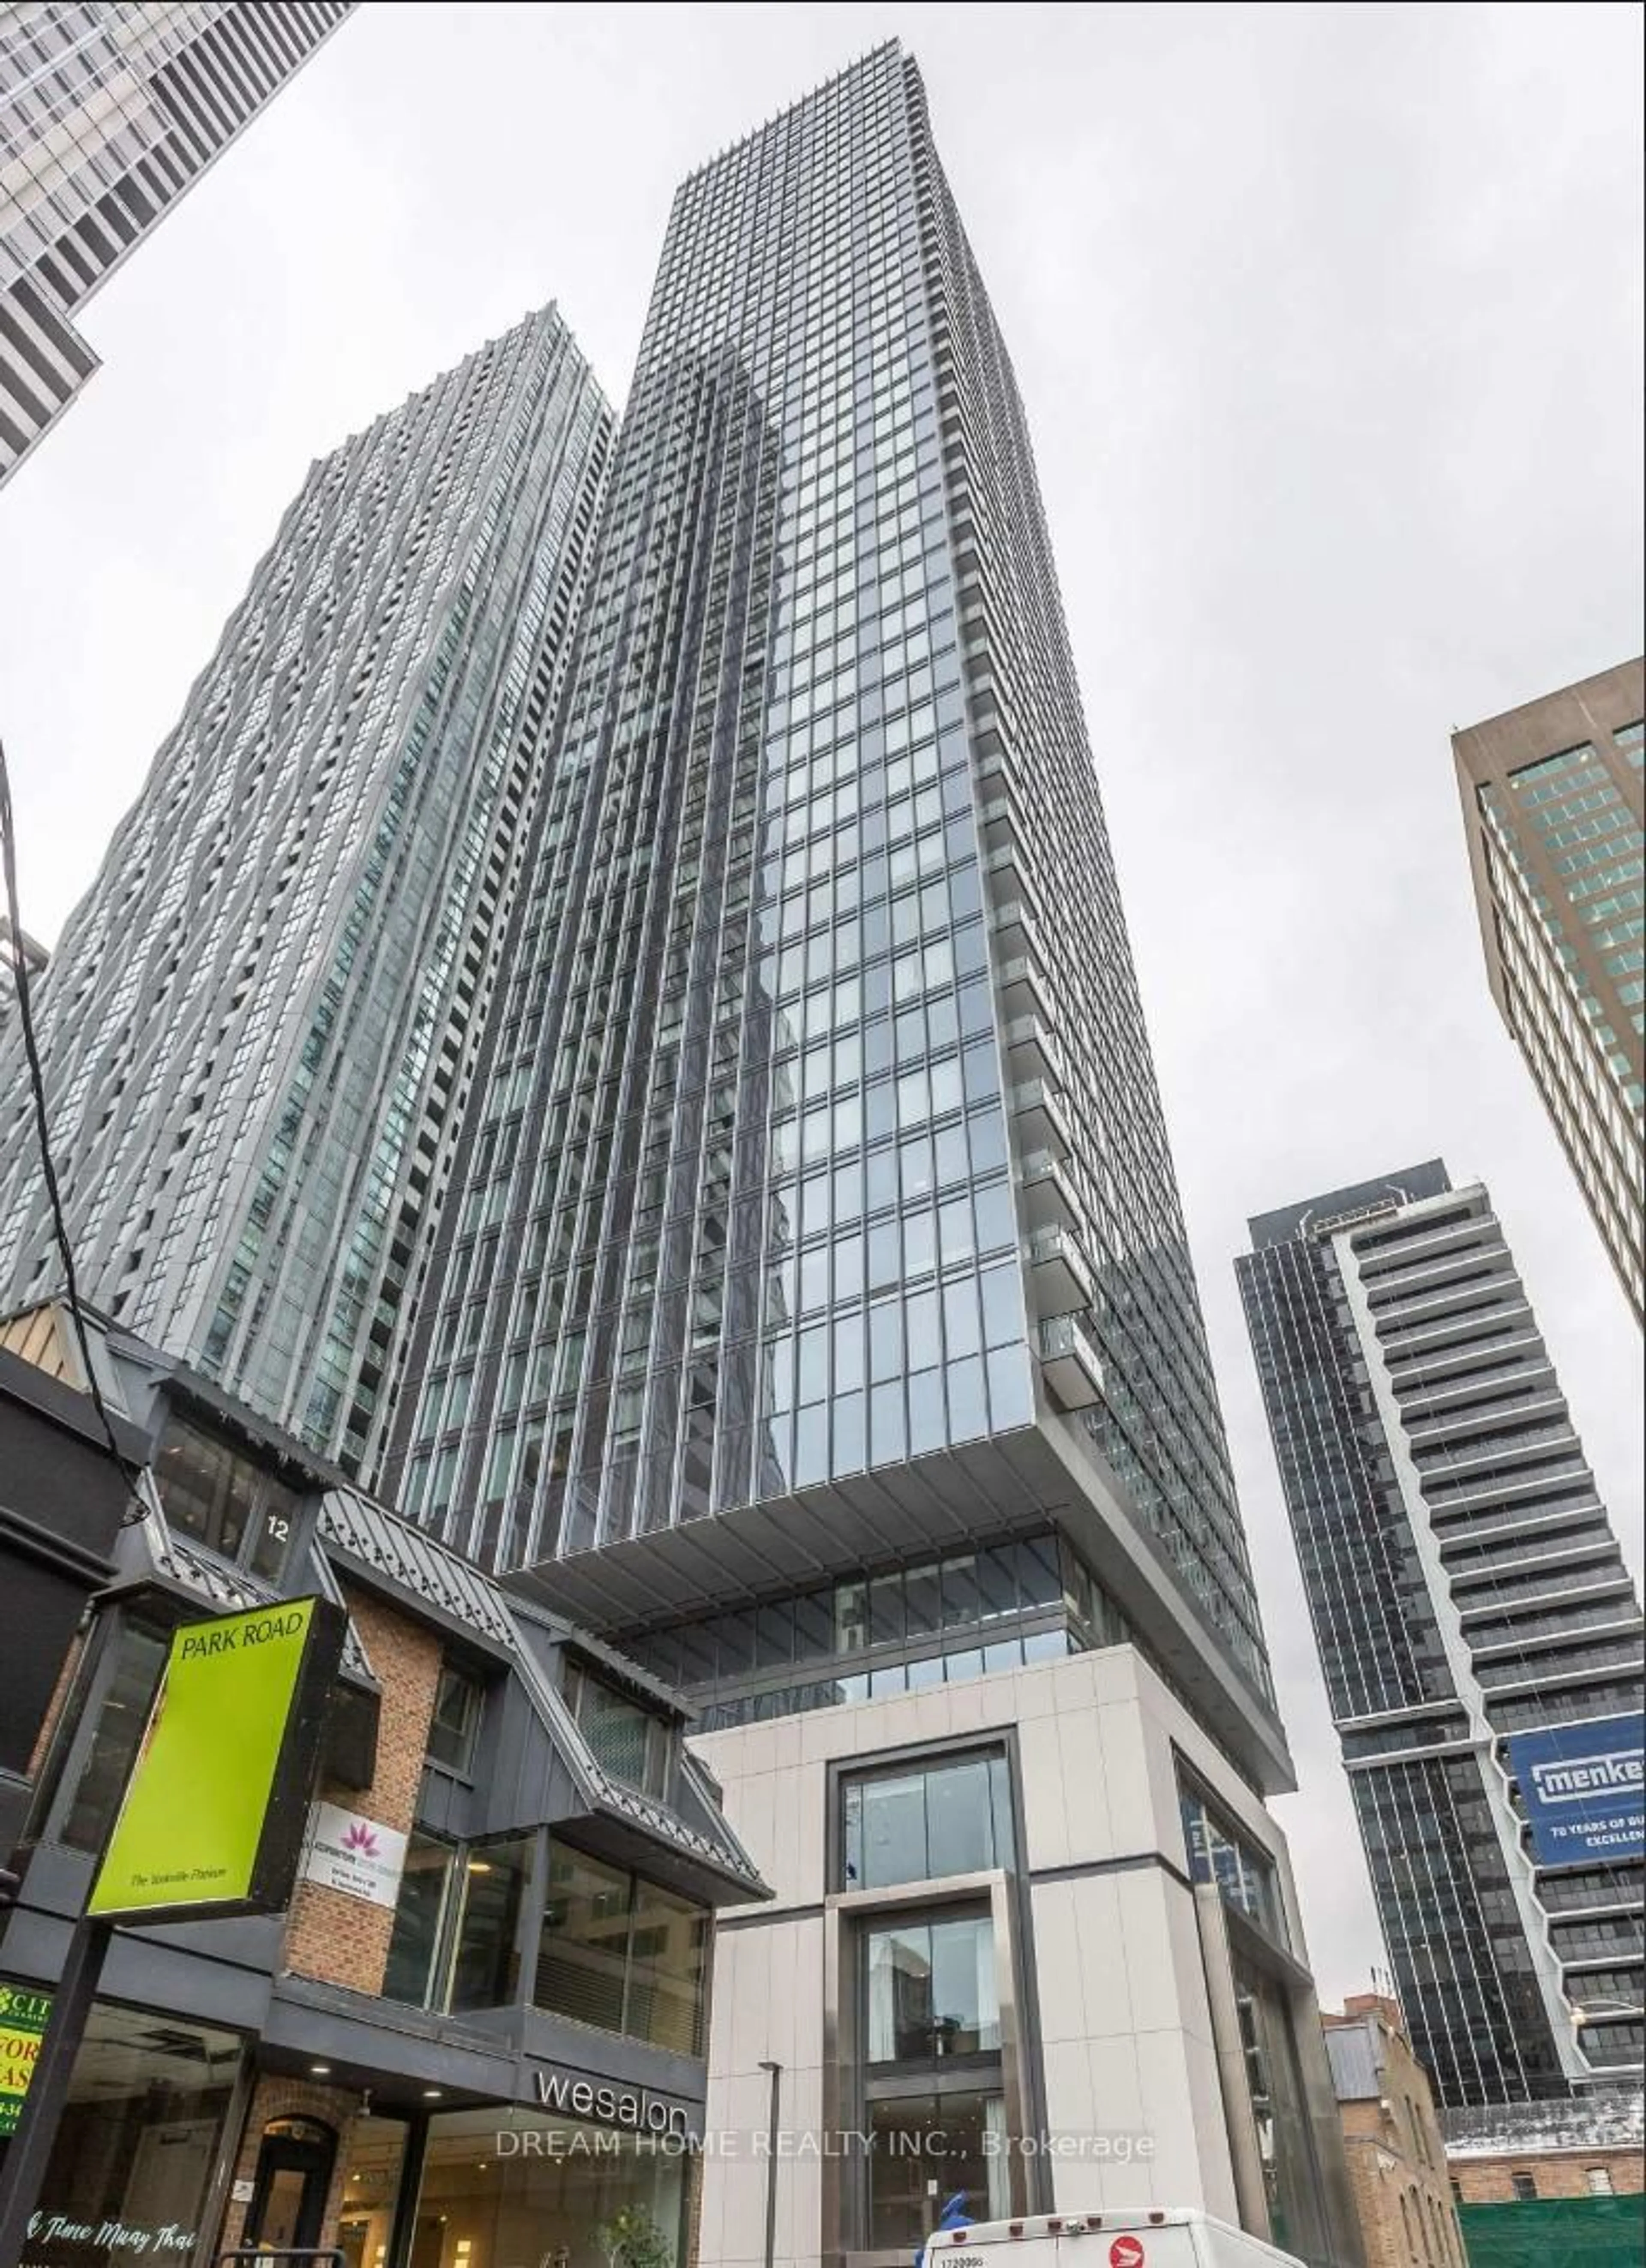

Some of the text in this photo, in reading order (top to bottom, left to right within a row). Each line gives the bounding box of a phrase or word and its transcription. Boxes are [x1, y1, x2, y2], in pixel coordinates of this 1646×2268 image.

[268, 1515, 288, 1542] 12
[182, 1612, 303, 1659] PARK ROAD
[1545, 1759, 1644, 1792] menke
[1568, 1820, 1607, 1835] YEARS
[1609, 1817, 1625, 1829] OF
[538, 2071, 688, 2133] wesalon
[93, 2221, 151, 2254] Muay
[153, 2223, 196, 2252] Thai
